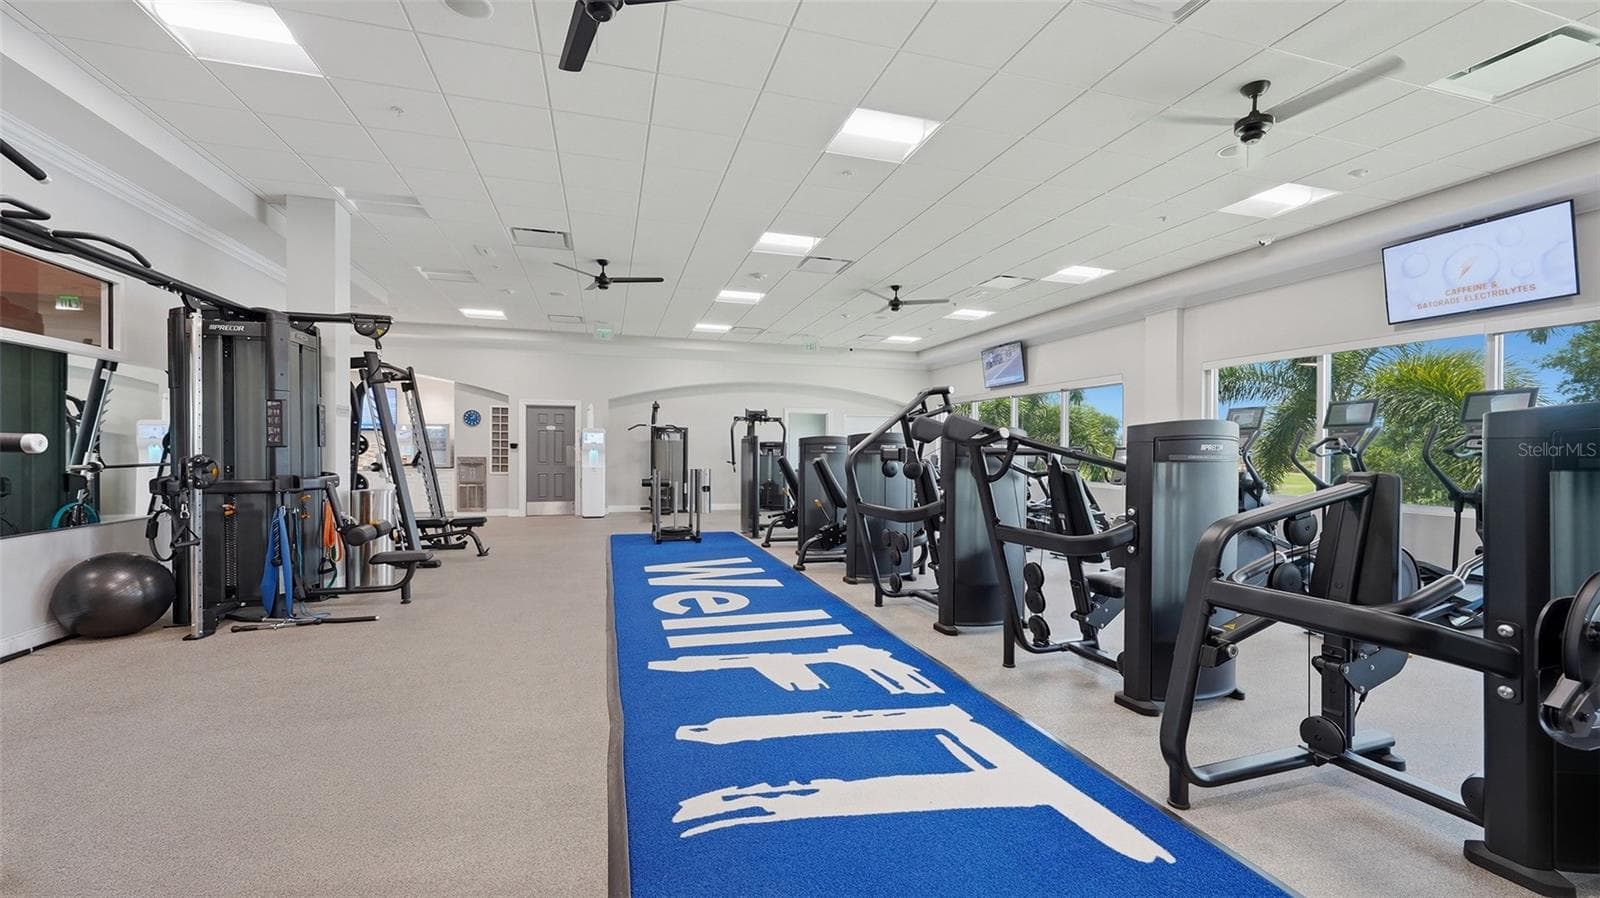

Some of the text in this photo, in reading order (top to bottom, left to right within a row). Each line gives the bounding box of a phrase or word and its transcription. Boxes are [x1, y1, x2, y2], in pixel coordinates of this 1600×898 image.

[1445, 280, 1499, 297] CAFFEINE &
[1463, 283, 1537, 302] ELECTROLYTES
[211, 324, 245, 332] PRECOR
